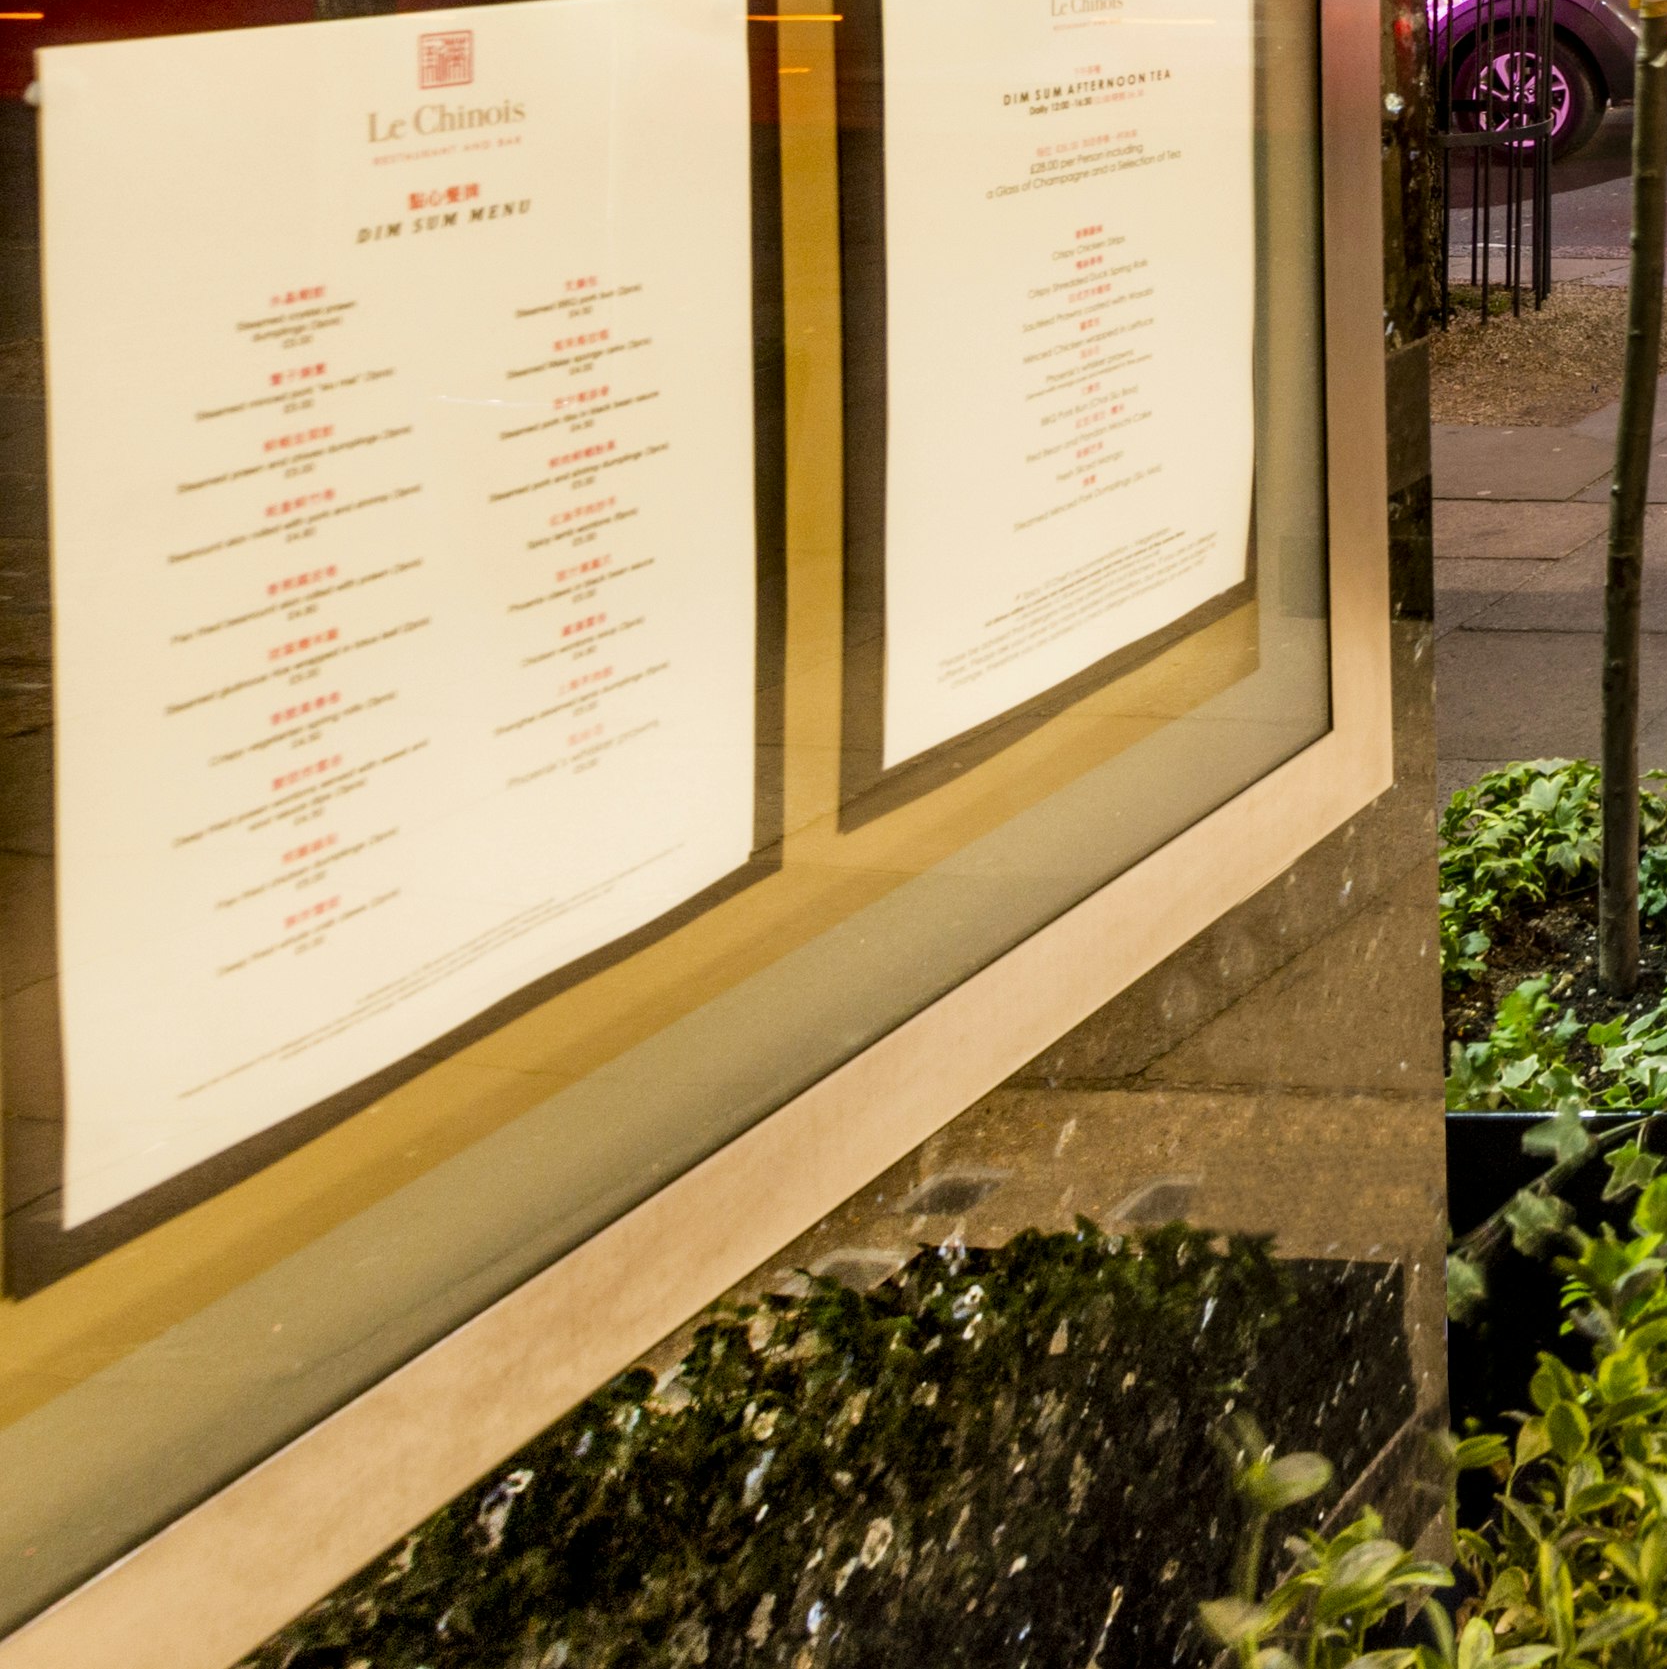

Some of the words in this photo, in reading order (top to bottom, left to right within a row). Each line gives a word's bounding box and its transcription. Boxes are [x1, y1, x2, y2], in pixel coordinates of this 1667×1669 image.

[1004, 92, 1029, 106] DIM
[1035, 87, 1062, 101] SUM
[1067, 73, 1146, 94] AFTERNOON
[1150, 69, 1171, 81] TEA
[368, 112, 406, 143] Le
[412, 99, 526, 135] Chinois
[357, 222, 402, 244] DIM
[414, 212, 457, 233] SUM
[470, 200, 530, 222] MENU
